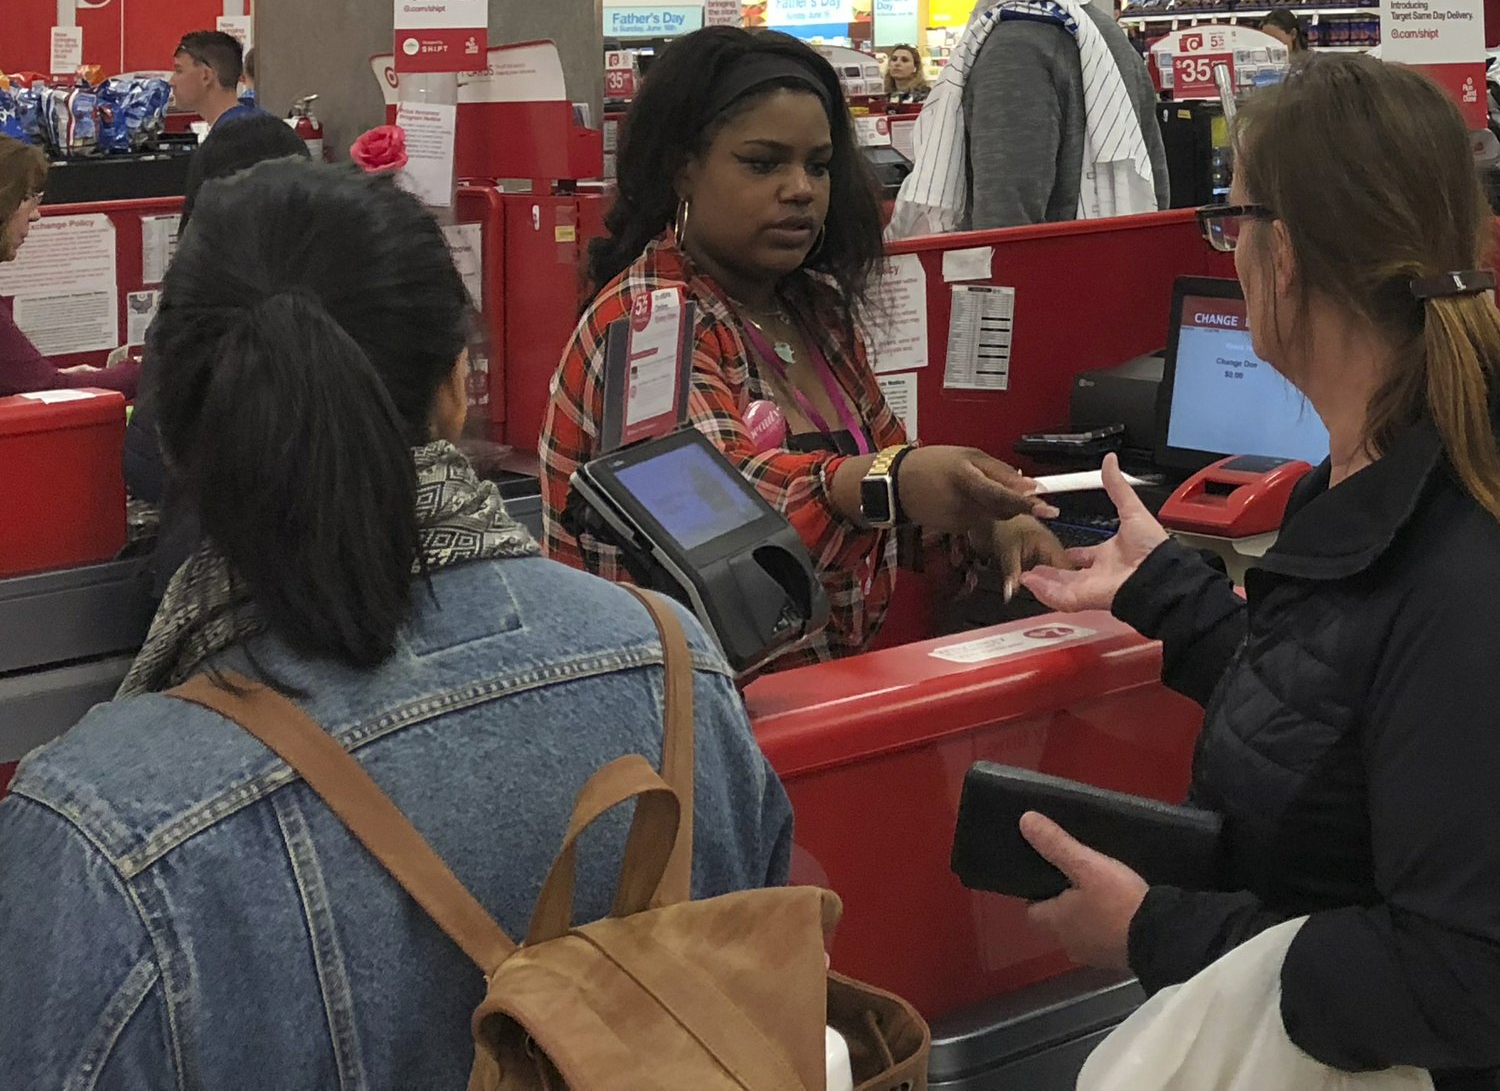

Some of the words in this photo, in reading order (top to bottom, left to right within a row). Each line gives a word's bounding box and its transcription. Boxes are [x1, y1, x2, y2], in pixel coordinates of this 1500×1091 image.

[877, 2, 893, 10] Day
[1390, 1, 1428, 10] Introducing
[612, 12, 660, 24] Father's
[663, 12, 685, 28] Day
[1391, 11, 1412, 21] Target
[1413, 11, 1431, 20] Same
[1432, 11, 1446, 20] Day
[1175, 59, 1211, 82] $35
[31, 221, 67, 230] xchange
[1194, 312, 1238, 327] CHANGE
[1216, 358, 1242, 368] Change
